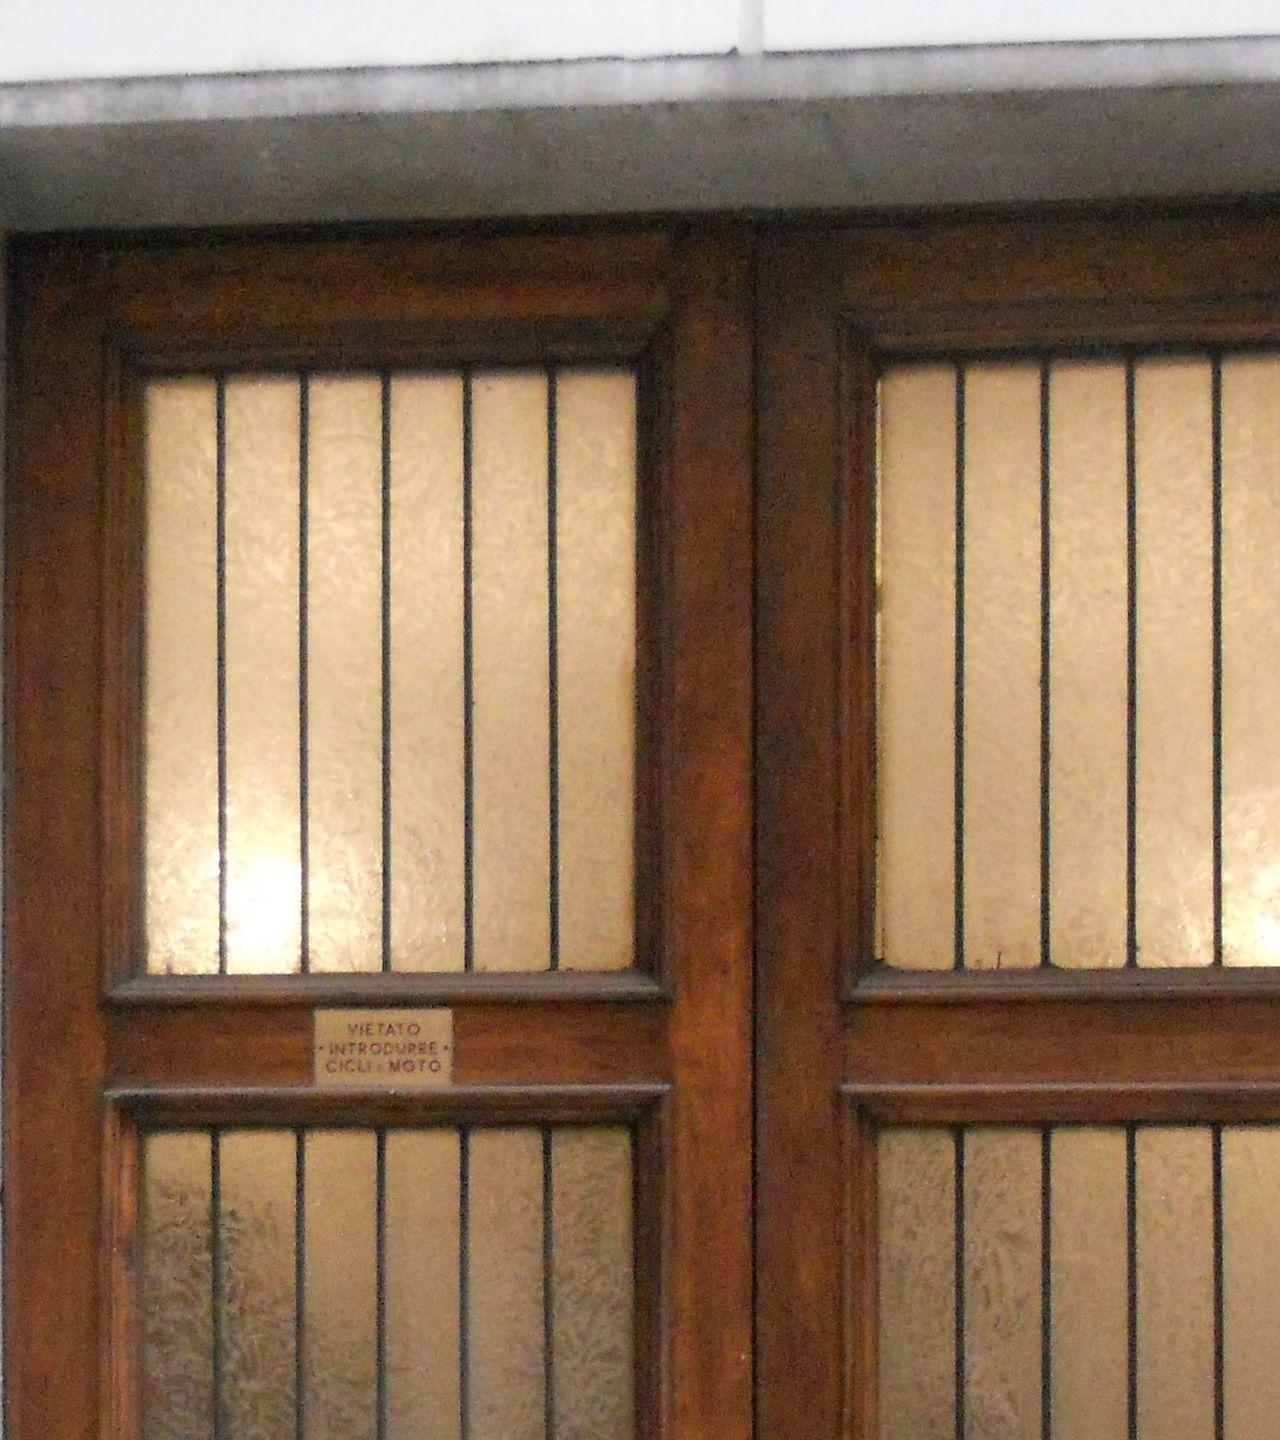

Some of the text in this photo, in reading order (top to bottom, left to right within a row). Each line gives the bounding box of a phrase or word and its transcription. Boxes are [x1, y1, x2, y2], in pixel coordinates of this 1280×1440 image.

[347, 1022, 421, 1036] VIETATO
[329, 1040, 438, 1056] INTRODURRE
[325, 1059, 371, 1073] CICLI
[388, 1058, 442, 1073] MOTO
